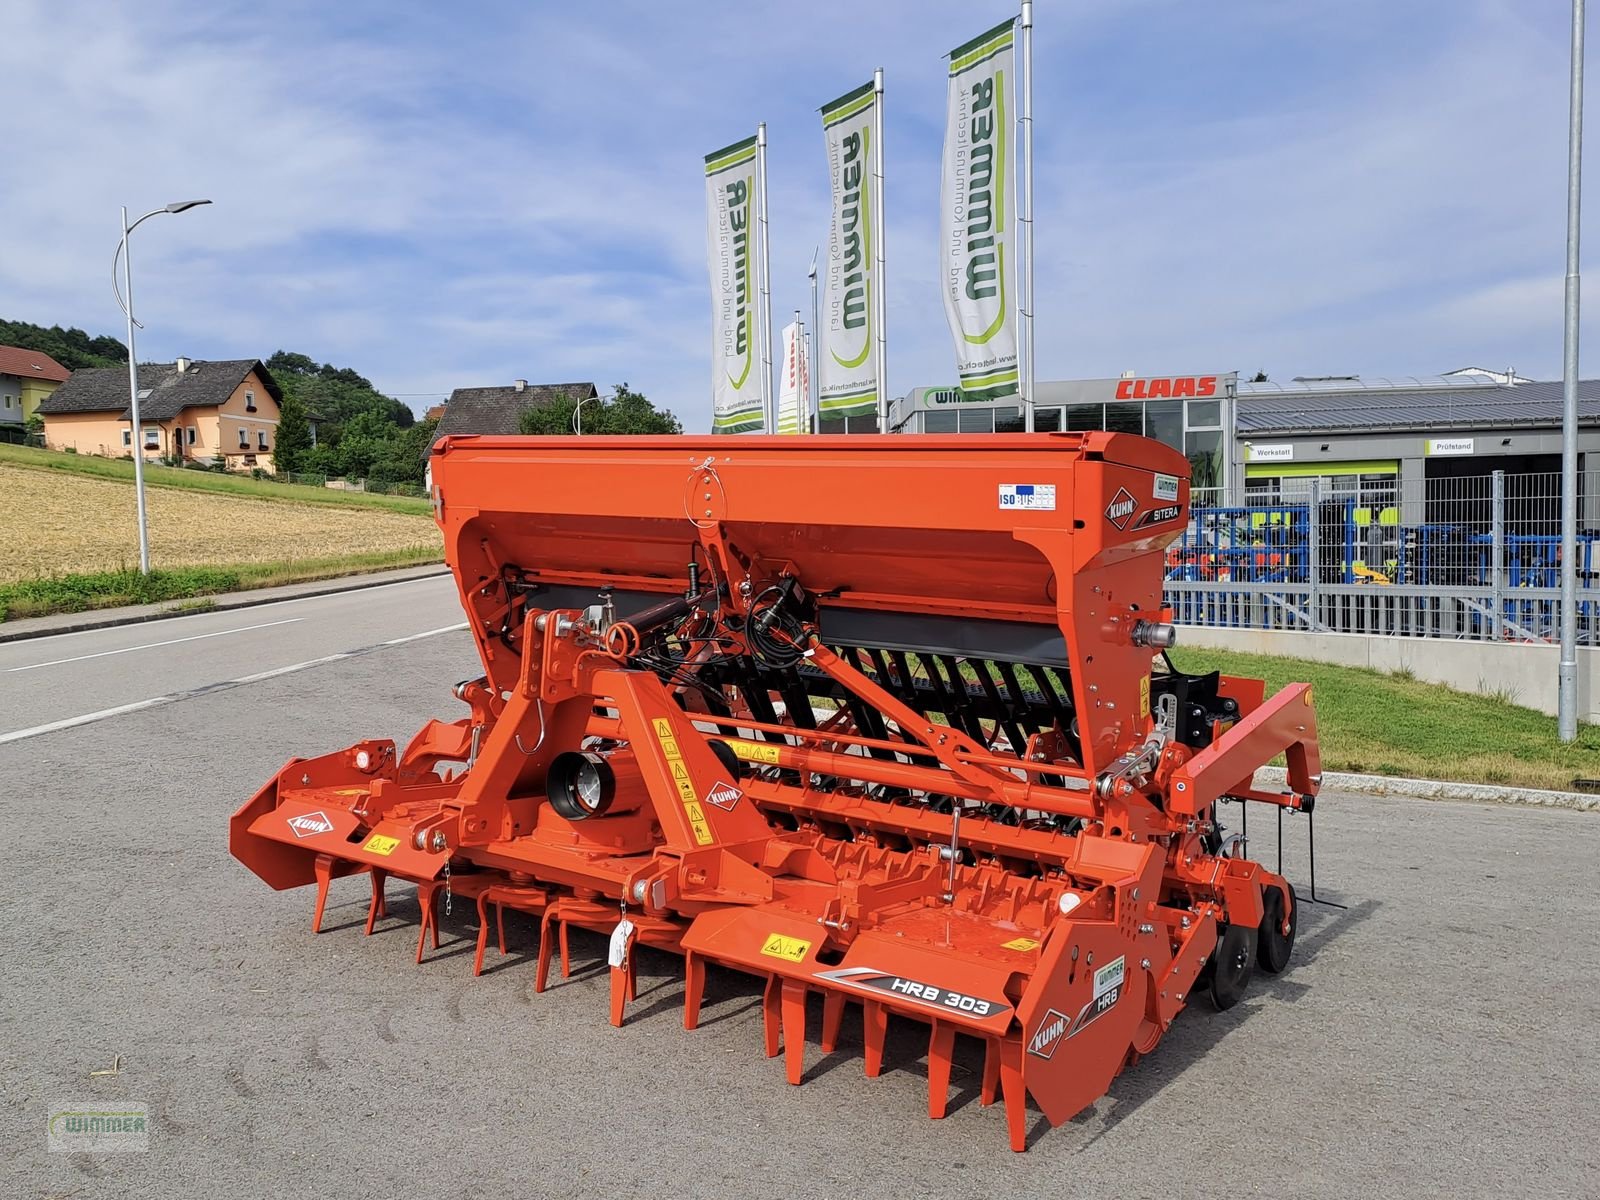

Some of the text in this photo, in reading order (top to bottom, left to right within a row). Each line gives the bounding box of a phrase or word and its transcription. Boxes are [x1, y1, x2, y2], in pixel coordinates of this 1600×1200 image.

[1115, 376, 1216, 400] CLAAS
[1110, 499, 1133, 520] KUHN
[1153, 506, 1178, 520] SITERA
[710, 789, 738, 804] KUHN
[294, 818, 328, 832] KUHN
[891, 978, 991, 1015] HRB 303
[1097, 988, 1118, 1012] HRB
[1034, 1017, 1064, 1051] KUHN
